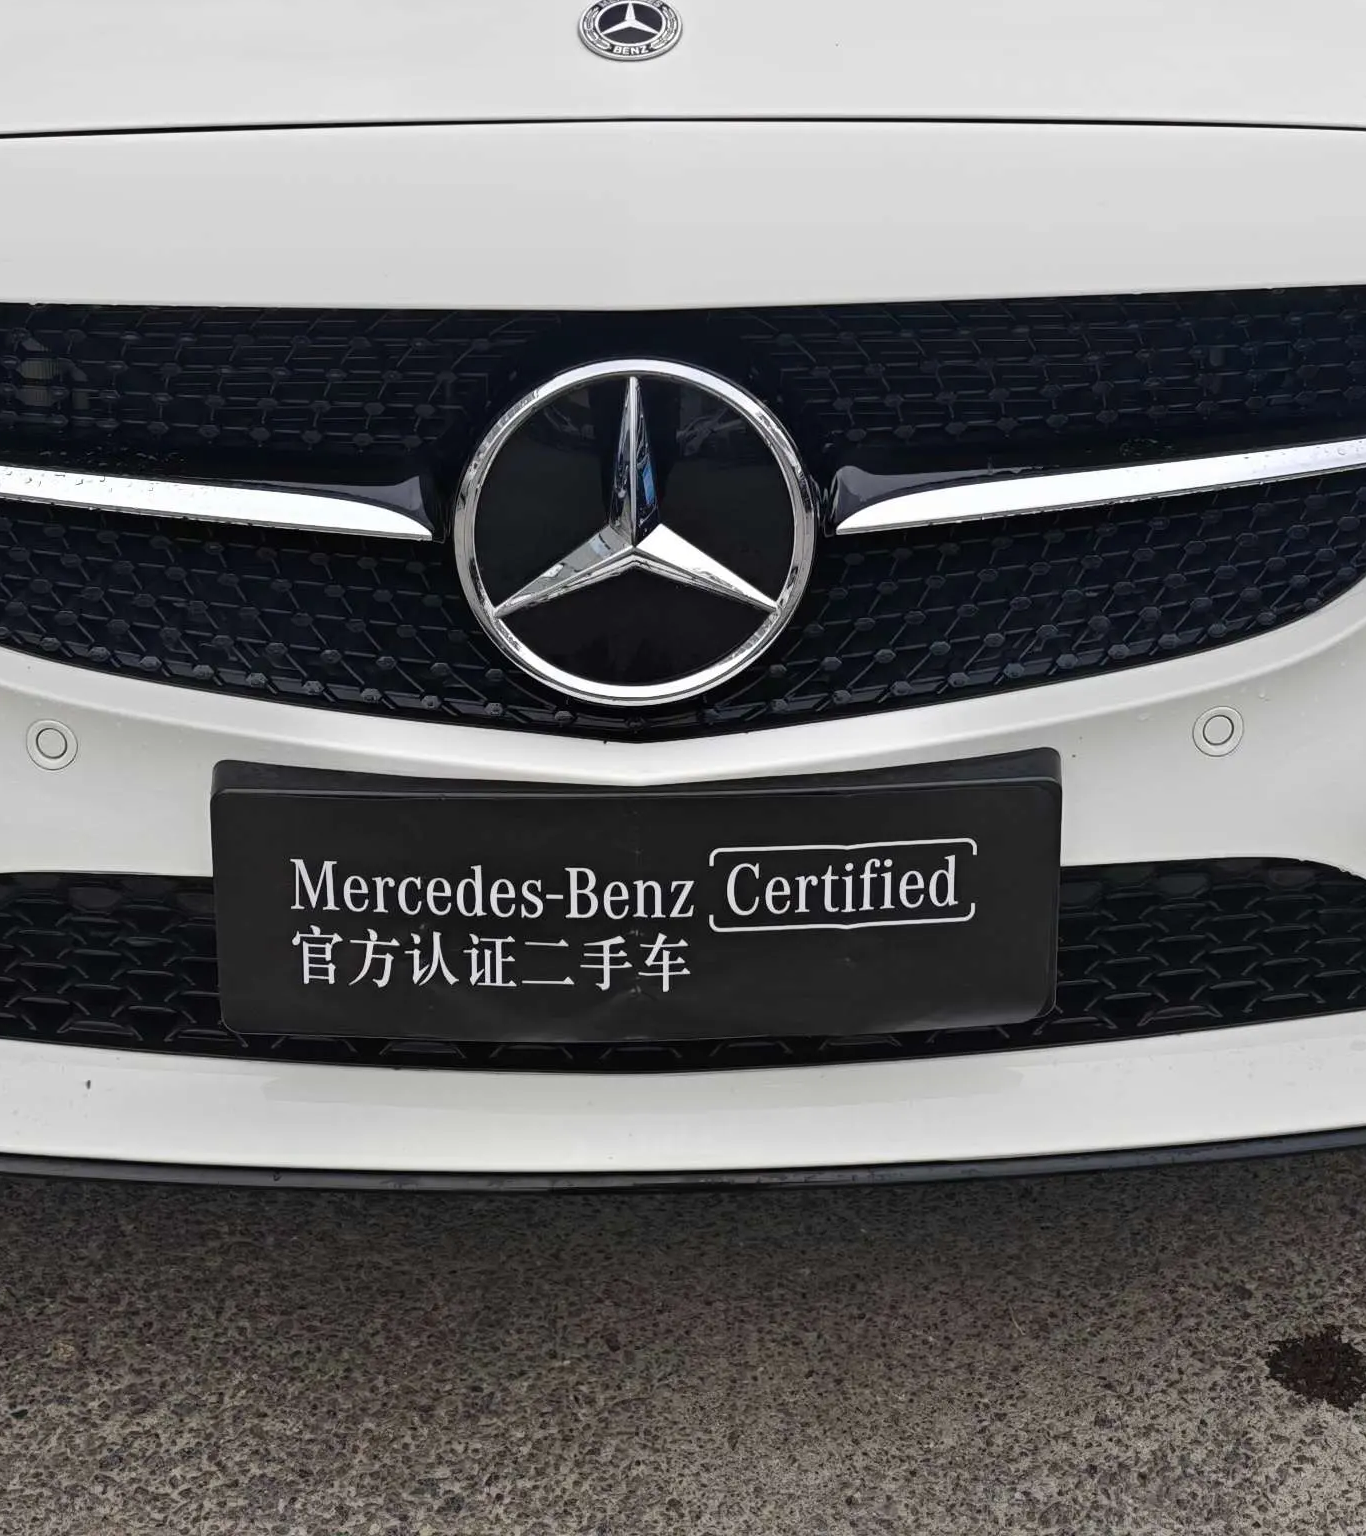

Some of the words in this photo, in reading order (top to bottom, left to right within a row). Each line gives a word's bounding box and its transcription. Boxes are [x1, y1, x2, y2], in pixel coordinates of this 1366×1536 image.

[613, 45, 649, 55] BENZ
[289, 858, 695, 921] Mercedes-Benz
[726, 854, 960, 917] Certified
[291, 924, 692, 993] 官方认证二手车
